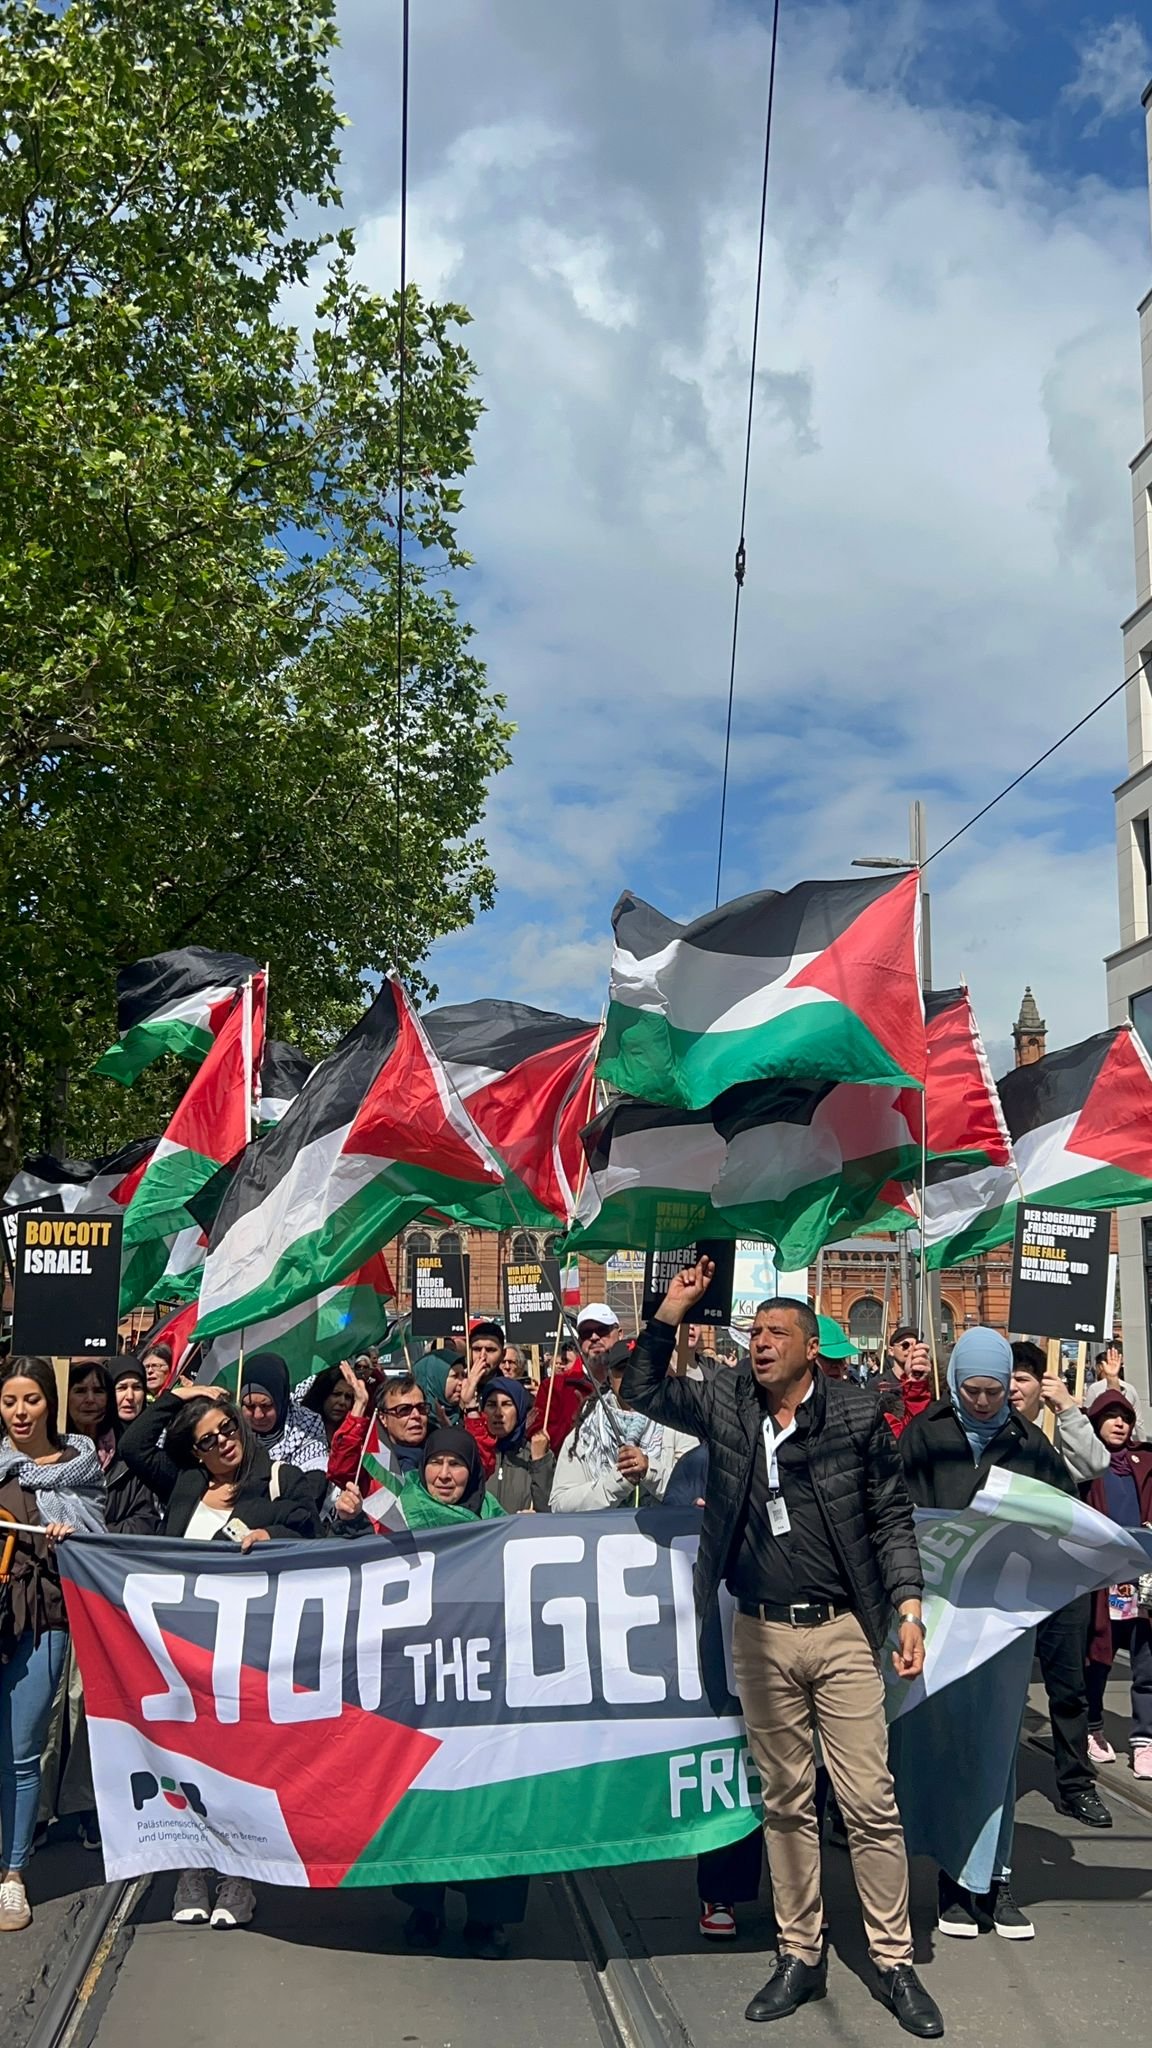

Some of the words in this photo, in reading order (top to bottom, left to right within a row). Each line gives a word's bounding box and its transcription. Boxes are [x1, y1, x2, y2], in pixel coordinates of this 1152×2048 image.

[1024, 1209, 1041, 1222] DER
[1042, 1211, 1097, 1228] SOGENANNTE
[25, 1220, 112, 1246] BOYCOTT
[1022, 1233, 1036, 1244] IST
[1037, 1234, 1055, 1247] NUR
[652, 1249, 698, 1265] ANDERE
[1022, 1244, 1041, 1257] EINE
[1042, 1247, 1067, 1260] FALLE
[24, 1249, 93, 1275] ISRAEL
[416, 1257, 443, 1268] ISRAEL
[1021, 1256, 1039, 1269] VON
[1039, 1259, 1070, 1272] TRUMP
[1070, 1262, 1089, 1275] UND
[416, 1267, 431, 1278] HAT
[1020, 1268, 1072, 1285] NETANYAHU.
[416, 1277, 444, 1288] KINDER
[508, 1275, 527, 1285] NICHT
[416, 1287, 453, 1298] LEBENDIG
[508, 1284, 538, 1294] SOLANGE
[416, 1297, 463, 1309] VERBRANNT!
[508, 1292, 554, 1303] DEUTSCHLAND
[509, 1302, 553, 1313] MITSCHULDIG
[1075, 1323, 1096, 1333] PGB
[85, 1338, 107, 1347] PGB
[122, 1551, 436, 1725] STOP
[404, 1637, 492, 1705] THE
[139, 1832, 156, 1843] und
